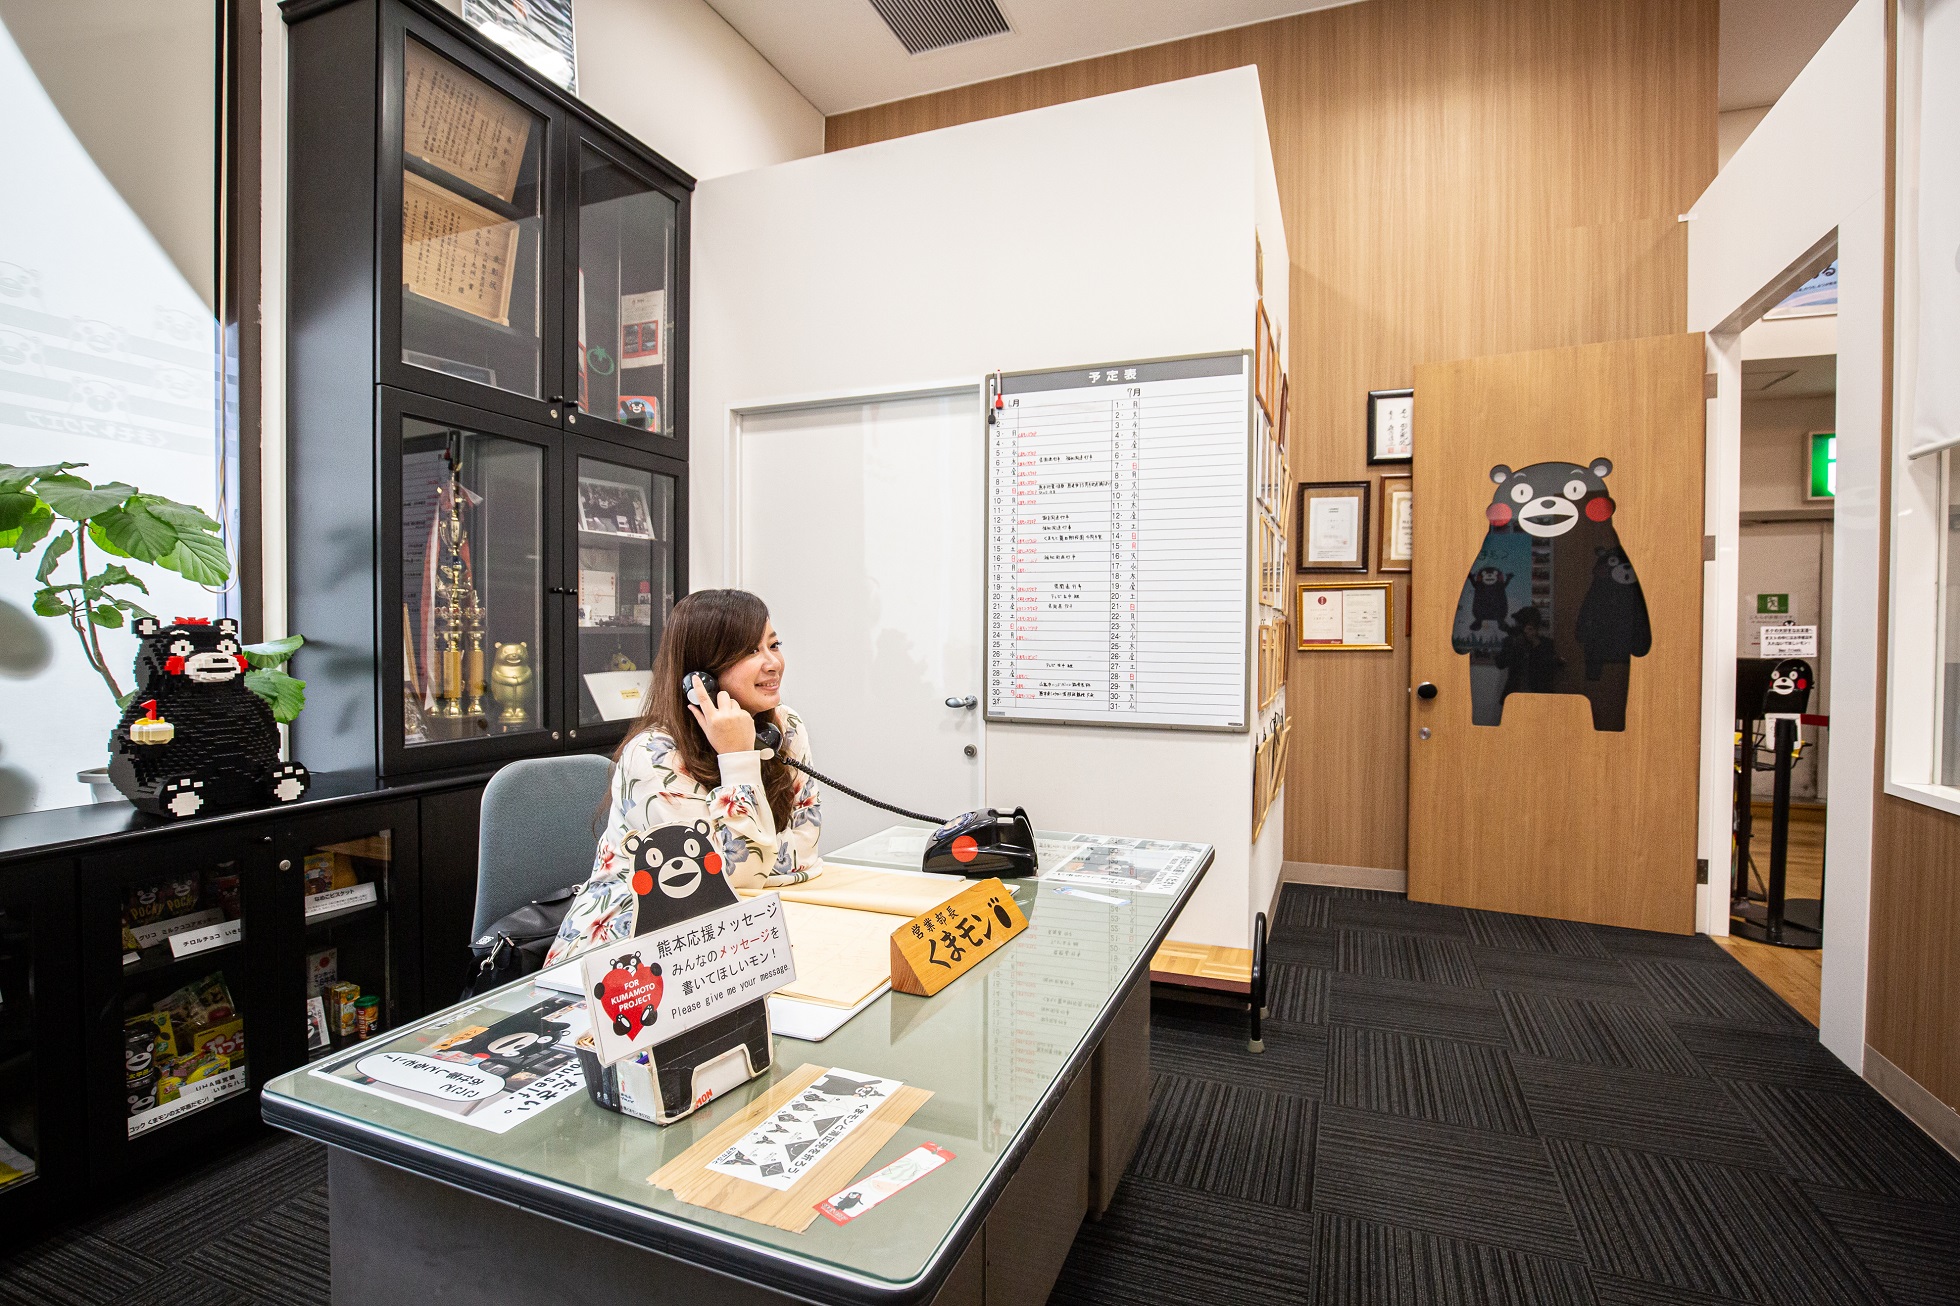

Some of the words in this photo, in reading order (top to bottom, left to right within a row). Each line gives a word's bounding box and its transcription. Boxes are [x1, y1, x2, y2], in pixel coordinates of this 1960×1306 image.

[1088, 368, 1137, 384] 予定表
[182, 933, 221, 948] チロルチョコ
[656, 902, 778, 960] 熊本応援メッセージ
[911, 905, 959, 940] 営業部長
[929, 913, 992, 969] くまモン
[672, 926, 780, 976] みんなのメッセージを
[624, 978, 640, 990] FOR
[682, 949, 776, 996] 書いてほしいモン!
[611, 983, 656, 1005] KUMAMOTO
[619, 993, 652, 1012] PROJECT
[671, 1001, 702, 1019] Please
[705, 991, 724, 1007] give
[727, 986, 737, 996] me
[740, 977, 756, 992] your
[760, 964, 790, 981] message.
[509, 1060, 581, 1100] ourself.
